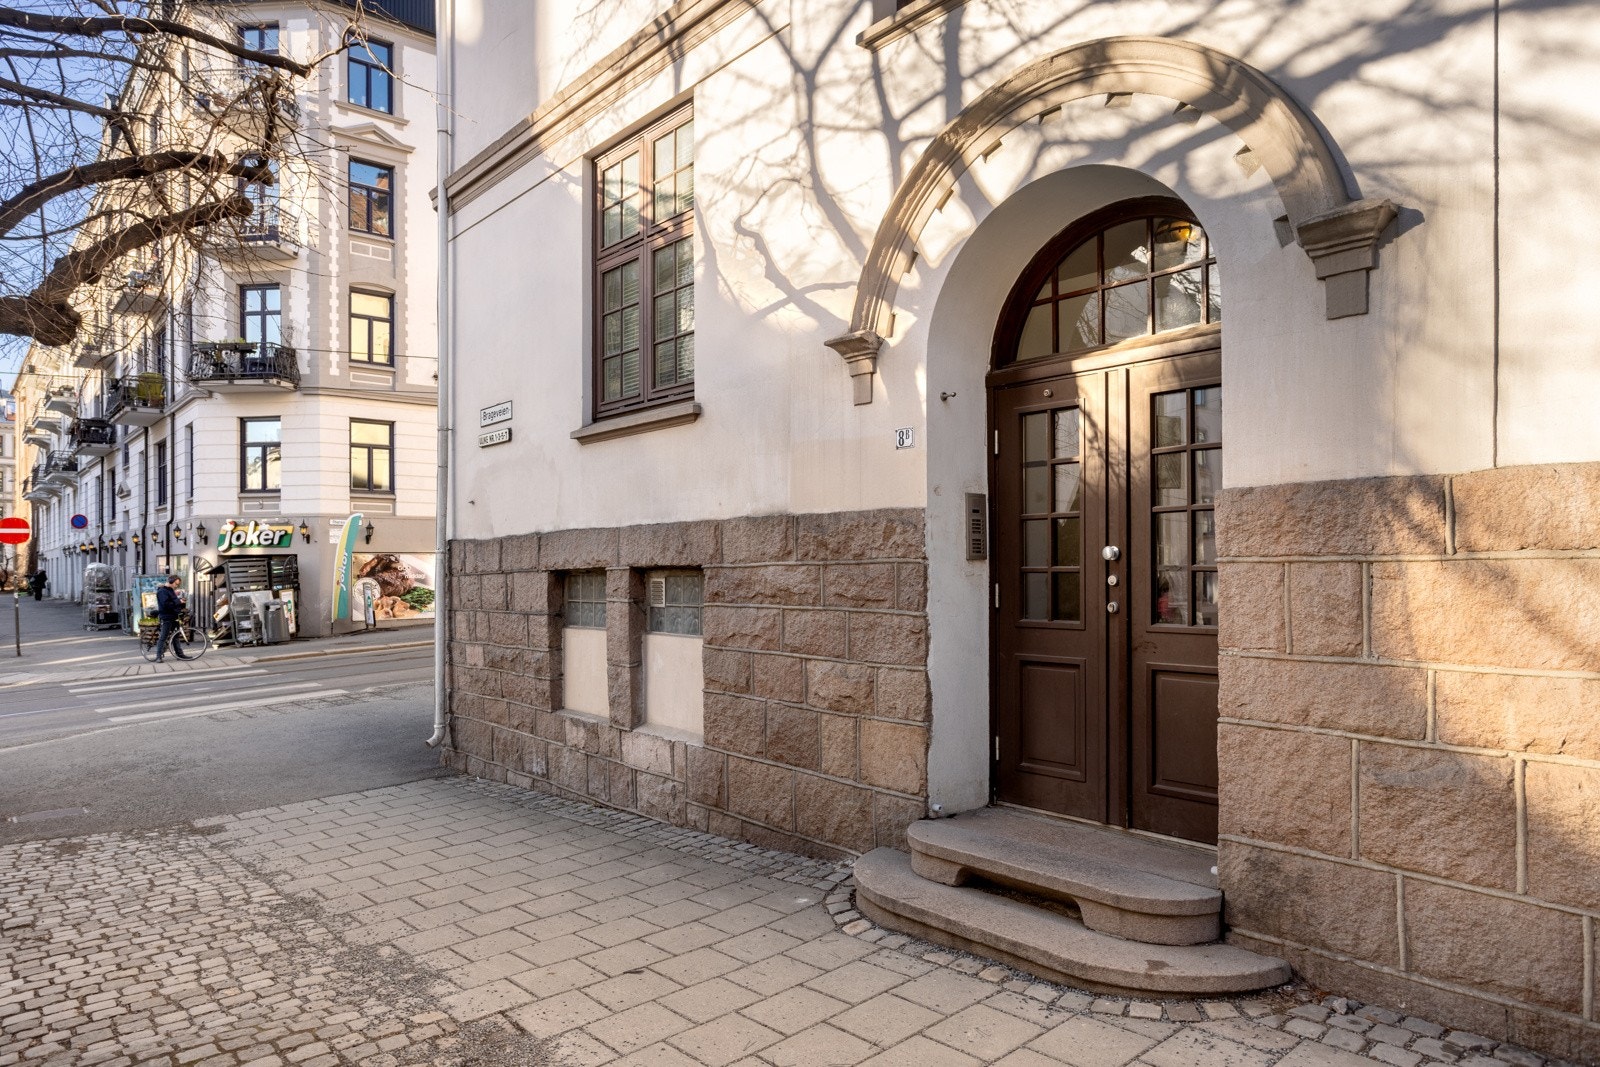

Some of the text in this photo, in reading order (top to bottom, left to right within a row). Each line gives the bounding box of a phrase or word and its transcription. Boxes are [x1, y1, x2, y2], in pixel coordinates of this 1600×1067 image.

[483, 407, 510, 421] Brageveien
[898, 429, 910, 447] 8B
[218, 519, 286, 552] joker
[337, 549, 348, 592] joker
